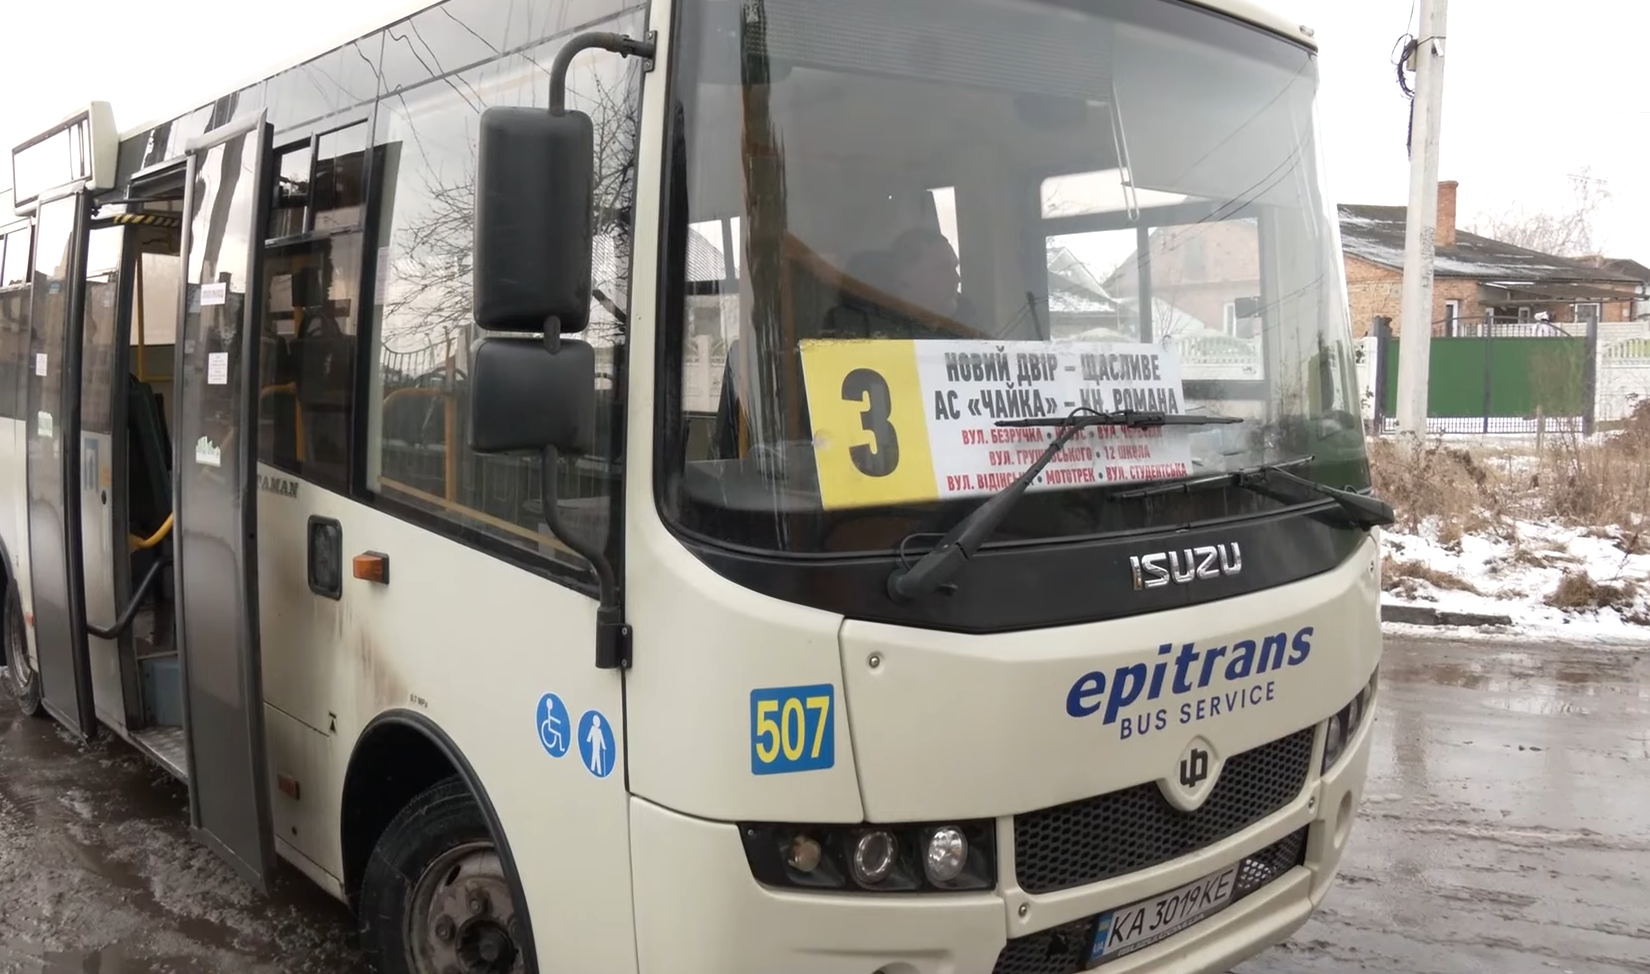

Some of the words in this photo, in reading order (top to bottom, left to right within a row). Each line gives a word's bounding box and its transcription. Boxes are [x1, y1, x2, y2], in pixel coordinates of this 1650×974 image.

[945, 346, 1011, 382] НОВИЙ
[1017, 353, 1058, 386] ДВІР
[1080, 353, 1161, 385] ЩАСЛИВЕ
[935, 390, 961, 420] АС
[967, 382, 1058, 418] «ЧАЙКА»
[1111, 387, 1179, 415] РОМАНА
[841, 368, 899, 477] 3
[962, 429, 988, 445] ВУЛ.
[990, 427, 1043, 443] БЕЗРУЧКА
[989, 450, 1014, 466] ВУЛ.
[1104, 445, 1116, 460] 12
[1117, 444, 1151, 460] ШКОЛА
[946, 475, 974, 491] ВУЛ.
[1046, 467, 1096, 485] МОТОТРЕК
[1105, 466, 1128, 481] ВУЛ.
[1129, 462, 1188, 481] СТУДЕНТСЬКА
[1130, 542, 1242, 590] ISUZU
[1065, 626, 1314, 725] epitrans
[756, 696, 830, 763] 507
[1120, 709, 1167, 740] BUS
[1179, 681, 1275, 724] SERVICE
[1107, 908, 1146, 948] KA
